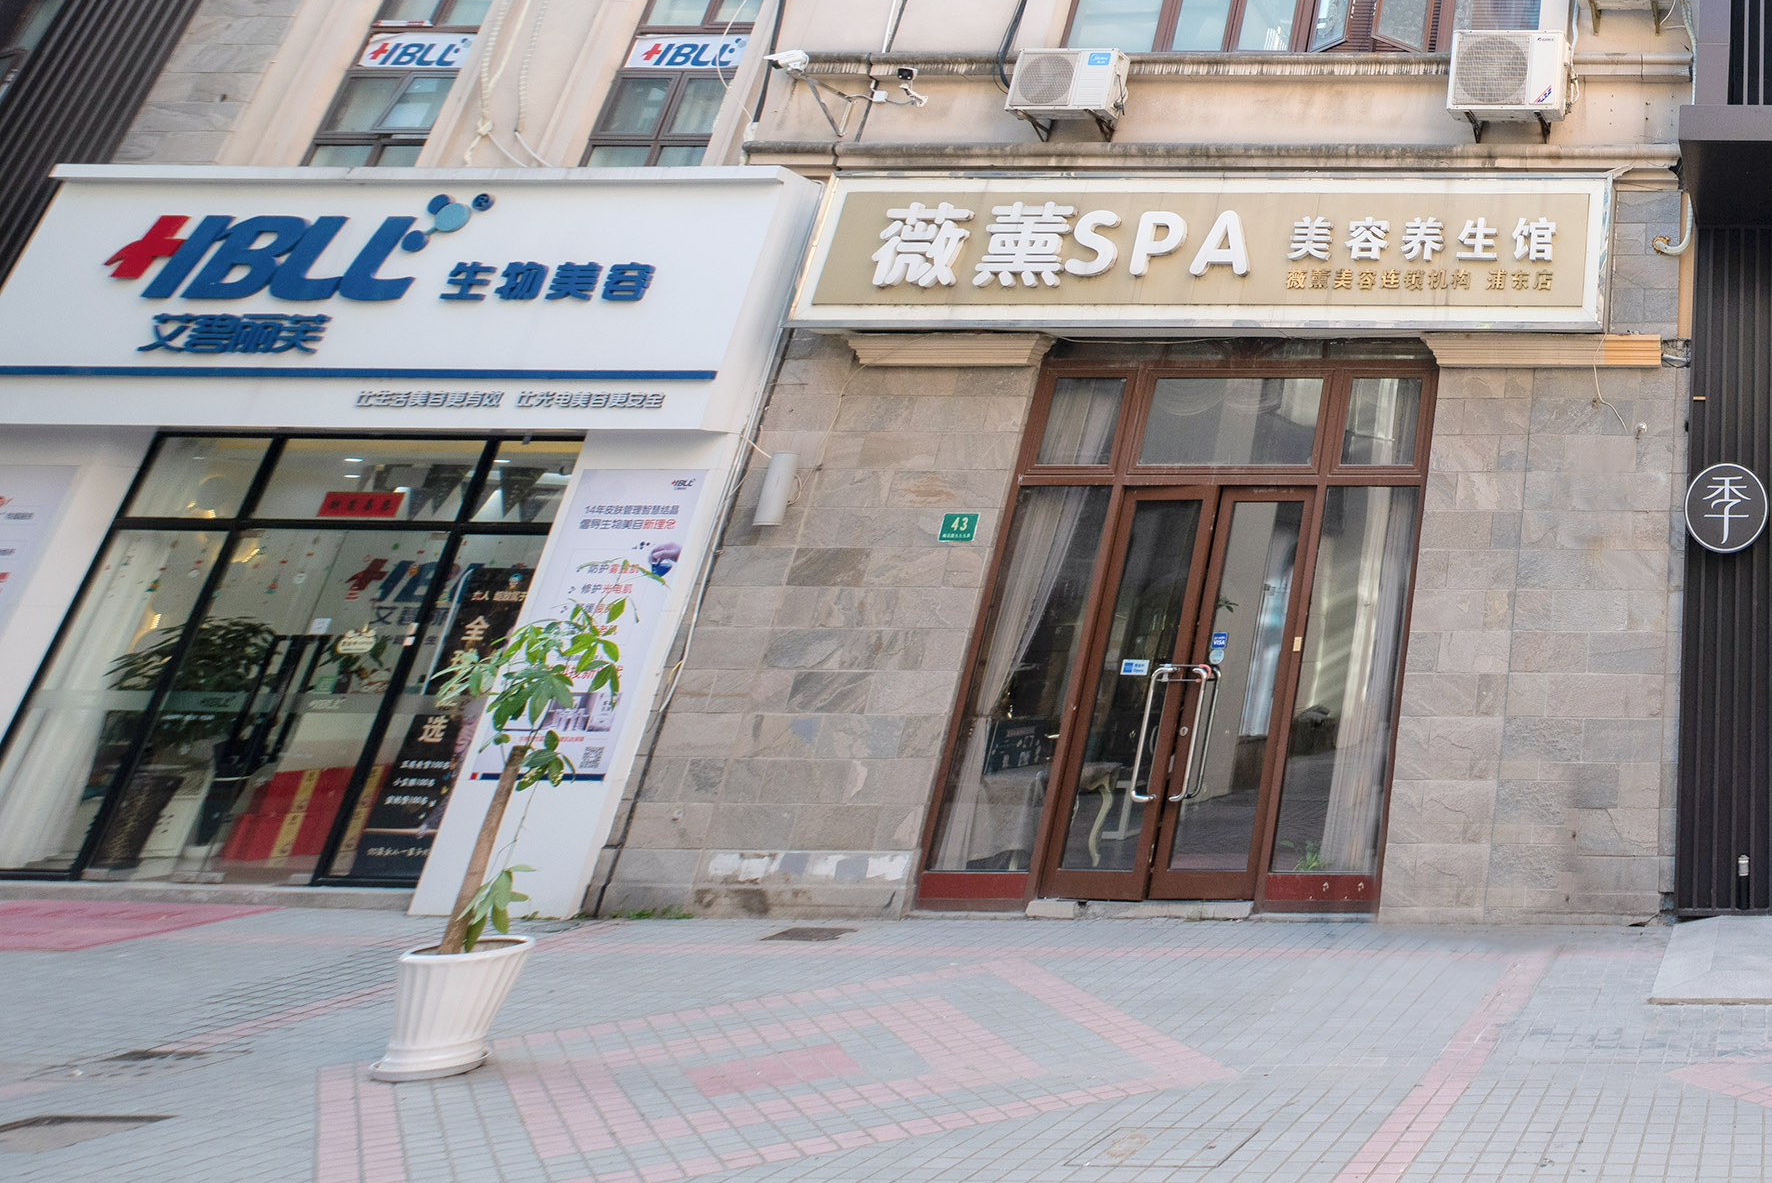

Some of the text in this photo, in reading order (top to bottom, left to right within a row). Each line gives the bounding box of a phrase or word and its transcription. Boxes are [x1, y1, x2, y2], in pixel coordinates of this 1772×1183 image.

[1287, 215, 1557, 262] 美容养生馆
[439, 260, 656, 302] 生物美容
[1486, 268, 1554, 291] 浦东店
[951, 516, 969, 531] 43
[1702, 474, 1751, 546] 季
